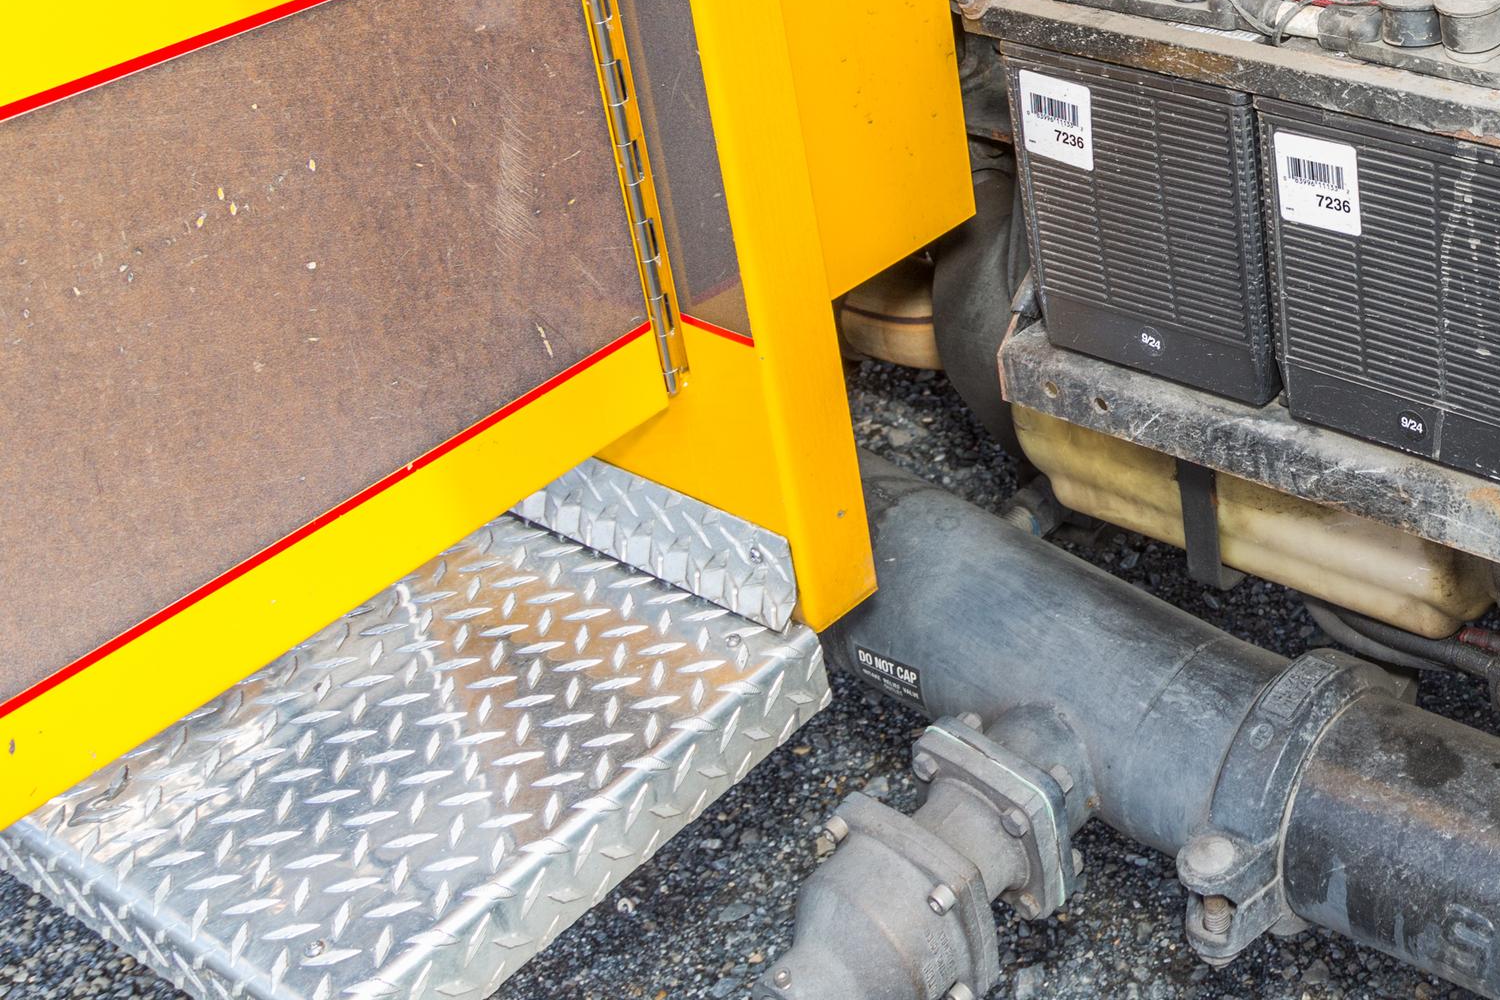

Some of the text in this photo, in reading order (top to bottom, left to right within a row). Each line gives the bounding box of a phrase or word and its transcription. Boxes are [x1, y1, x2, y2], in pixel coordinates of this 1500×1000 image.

[1054, 129, 1084, 149] 7236
[1315, 194, 1351, 213] 7236
[1141, 333, 1160, 350] 9/24
[1401, 416, 1423, 434] 9/24
[858, 649, 917, 684] DO NOT CAP
